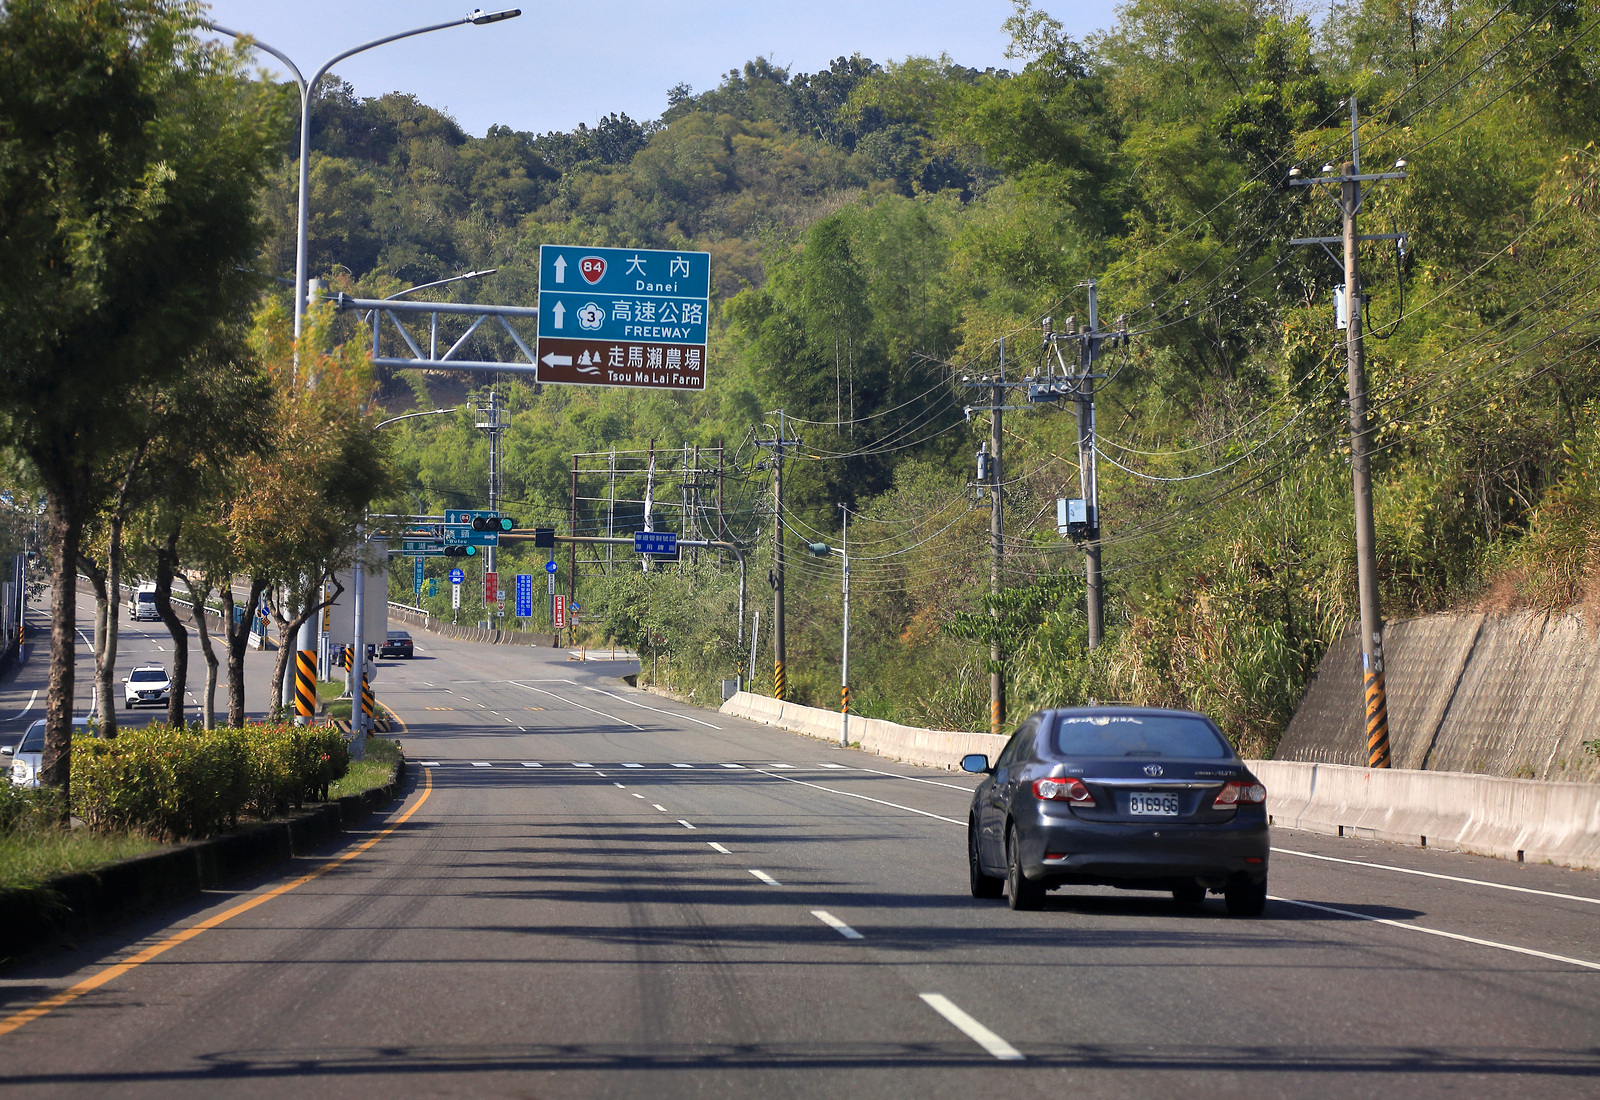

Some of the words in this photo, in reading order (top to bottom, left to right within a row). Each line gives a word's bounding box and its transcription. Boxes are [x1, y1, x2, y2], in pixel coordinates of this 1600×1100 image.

[583, 261, 602, 272] 84
[625, 254, 690, 278] 大內
[636, 280, 678, 292] Danei
[586, 311, 596, 322] 3
[612, 300, 703, 325] 高速公路
[624, 325, 691, 339] FREEWAY
[608, 345, 701, 371] 走馬瀨農場
[608, 370, 632, 382] Tsou
[635, 371, 649, 383] Ma
[652, 372, 669, 384] Lai
[672, 373, 700, 385] Farm
[1131, 797, 1178, 812] 8169-G6
